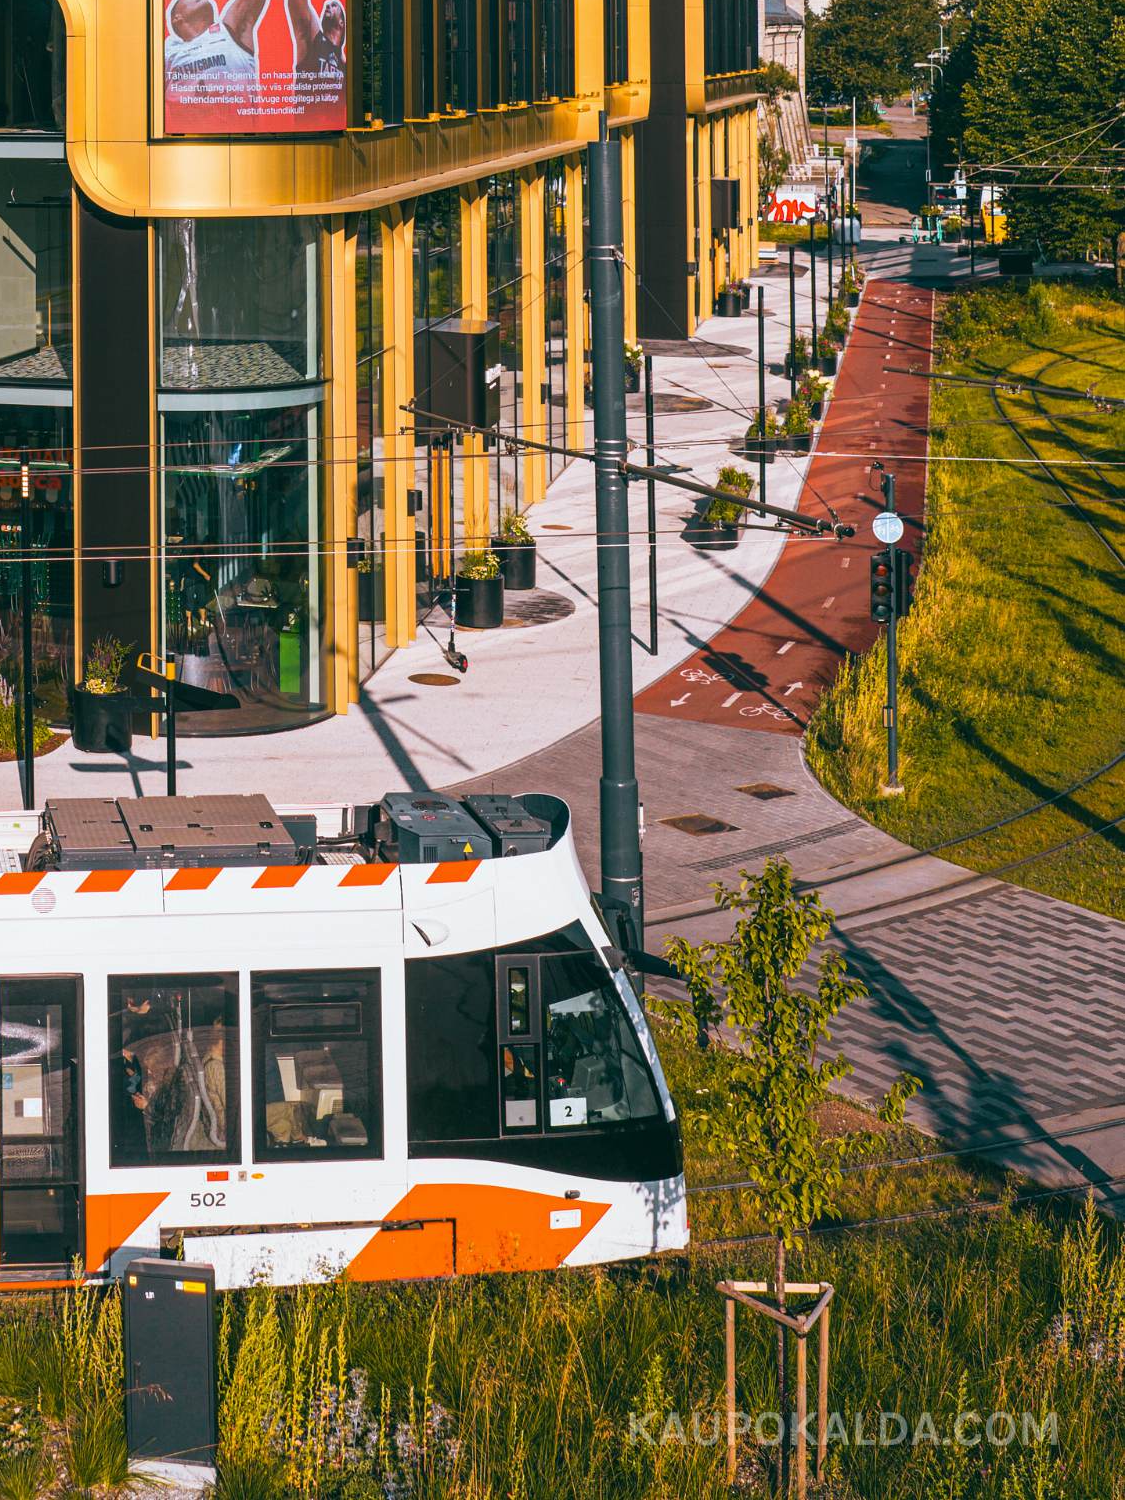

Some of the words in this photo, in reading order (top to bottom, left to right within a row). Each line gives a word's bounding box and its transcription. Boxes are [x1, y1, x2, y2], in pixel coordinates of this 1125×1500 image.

[226, 84, 245, 93] pole
[248, 95, 280, 104] Tutvuge
[564, 1105, 573, 1118] 2
[190, 1192, 226, 1208] 502
